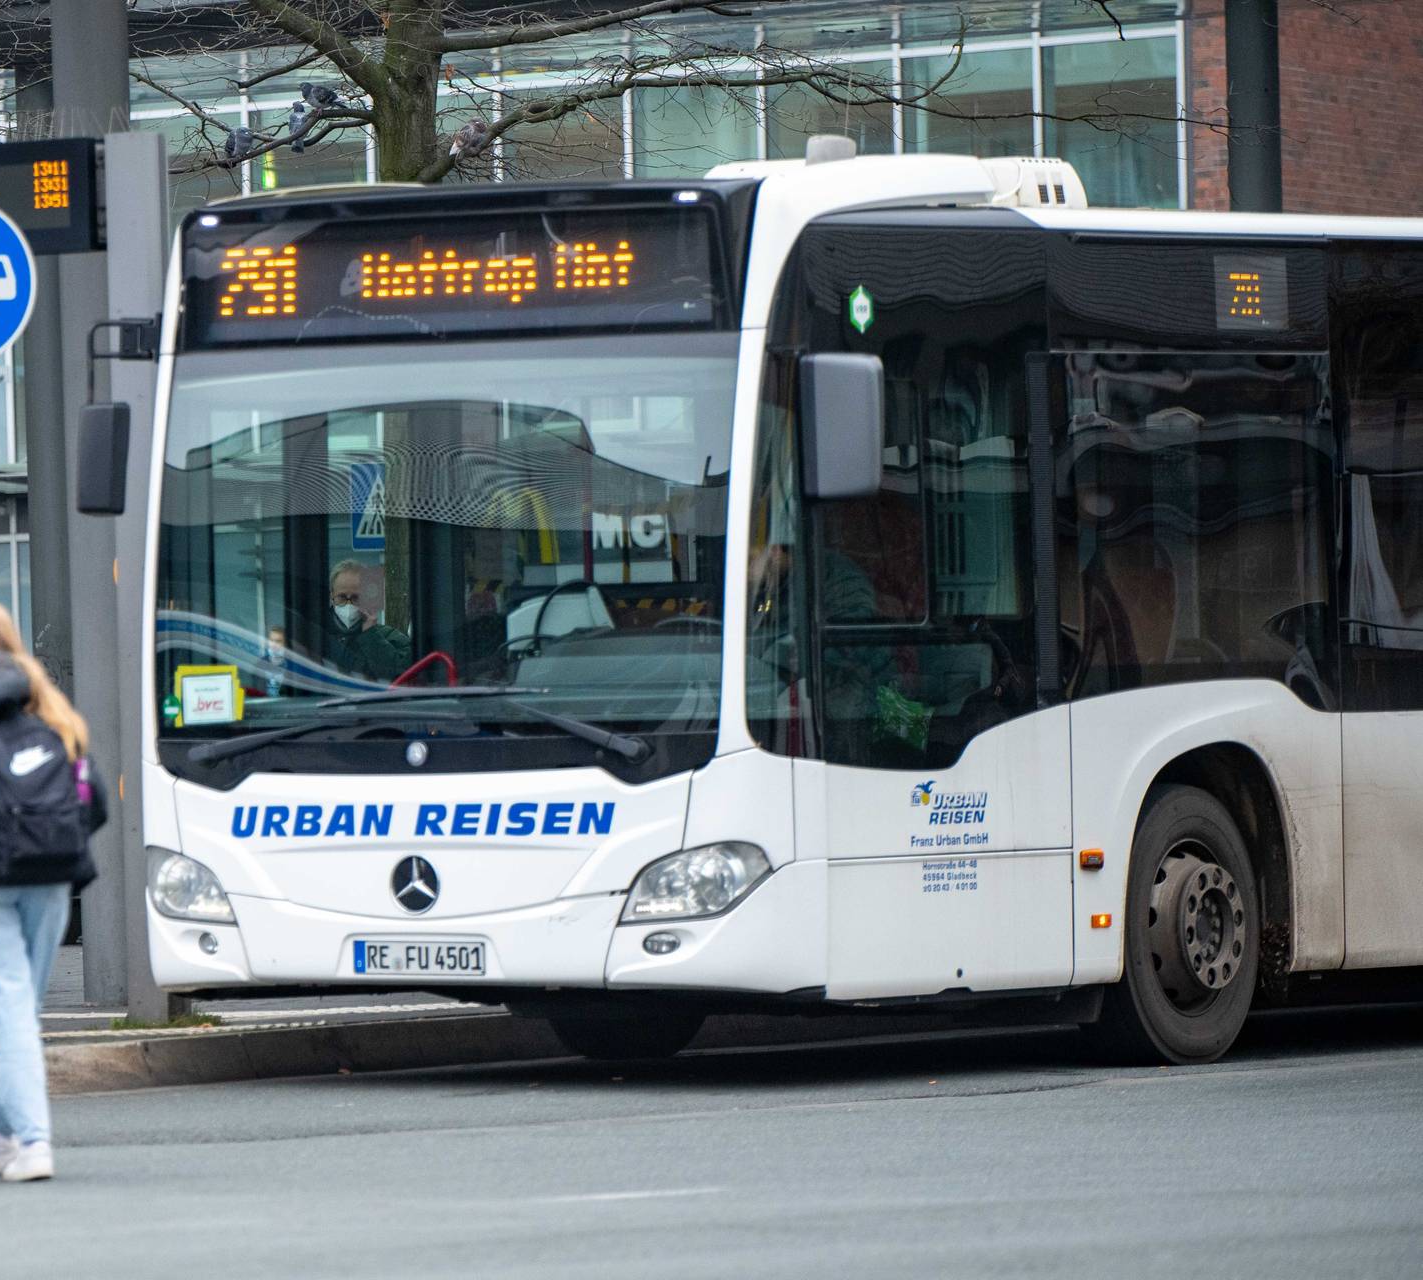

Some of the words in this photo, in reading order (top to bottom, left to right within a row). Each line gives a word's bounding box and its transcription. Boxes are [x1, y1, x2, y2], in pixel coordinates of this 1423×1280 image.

[33, 160, 68, 176] 13:11
[33, 176, 68, 192] 13:31
[34, 193, 69, 209] 13:51
[933, 792, 987, 810] URBAN
[231, 804, 393, 838] URBAN
[413, 802, 615, 836] REISEN
[929, 810, 985, 825] REISEN
[911, 836, 933, 847] Franz
[936, 835, 961, 846] Urban
[963, 833, 989, 844] GmbH
[947, 872, 977, 880] Gladbeck
[367, 945, 390, 969] RE
[406, 946, 429, 970] FU
[435, 946, 482, 970] 4501
